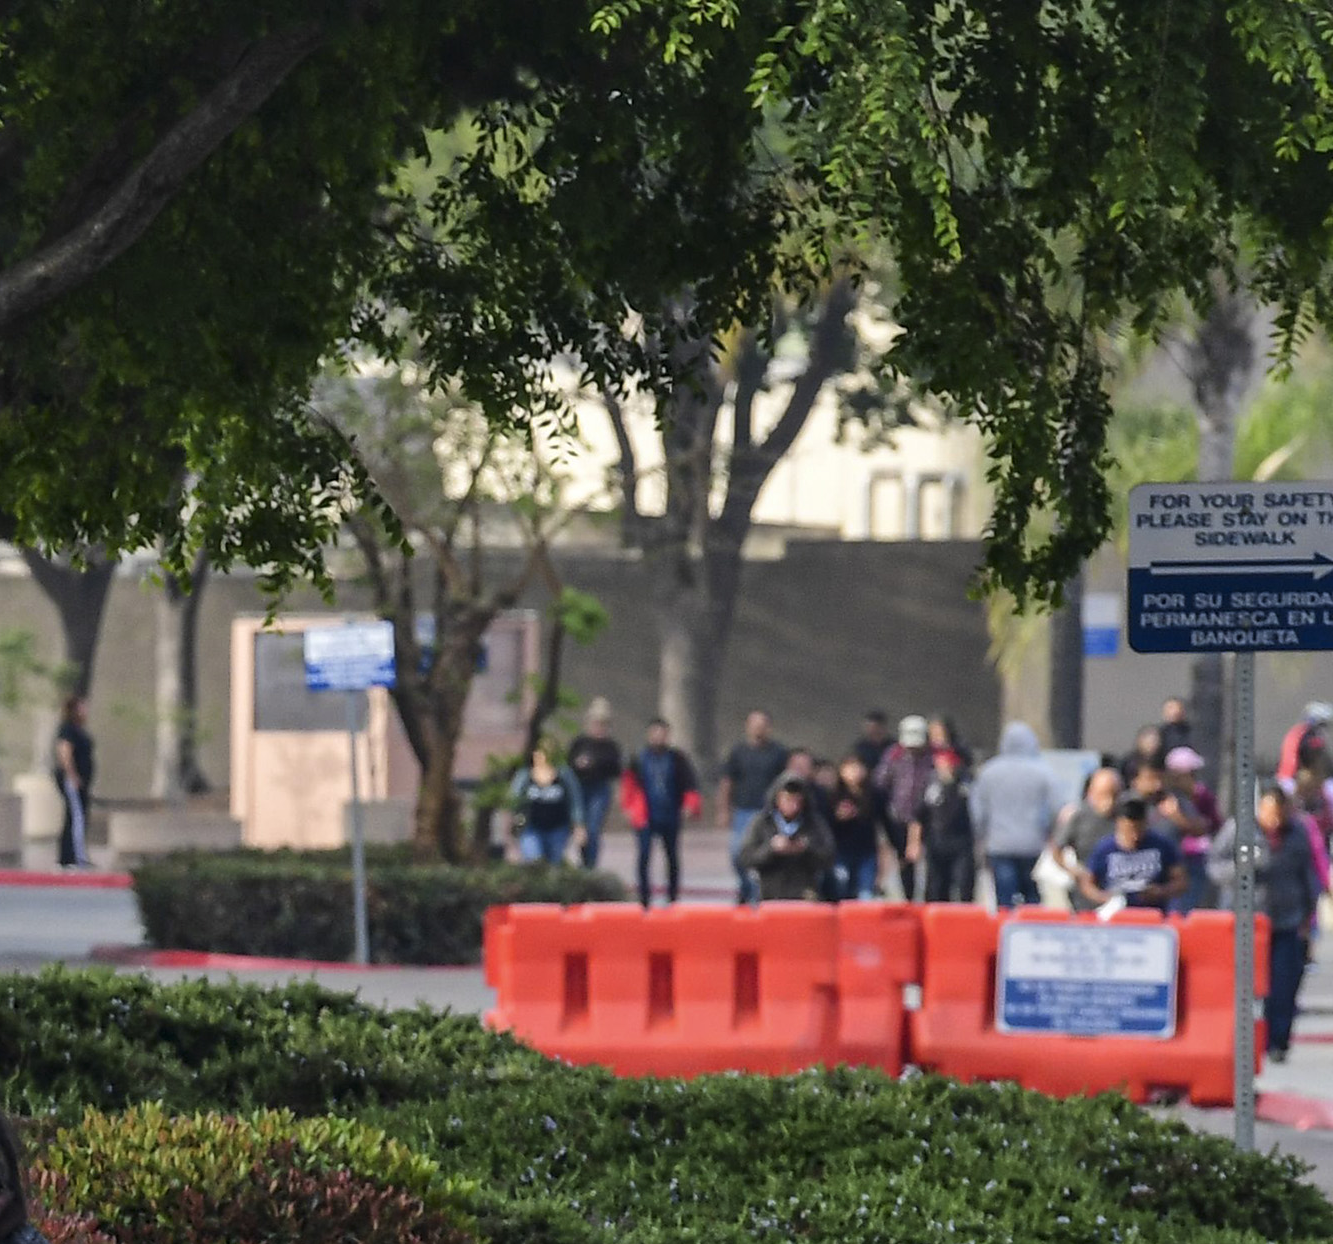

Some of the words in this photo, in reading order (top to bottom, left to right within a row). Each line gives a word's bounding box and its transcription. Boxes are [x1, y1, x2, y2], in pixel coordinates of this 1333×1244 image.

[1149, 494, 1190, 510] FOR
[1199, 494, 1254, 508] YOUR
[1137, 513, 1212, 528] PLEASE
[1222, 512, 1268, 528] STAY
[1278, 512, 1307, 526] ON
[1195, 531, 1296, 546] SIDEWALK
[1142, 594, 1185, 609] POR
[1194, 593, 1222, 608] SU
[1231, 592, 1333, 608] SEGURIDA
[1140, 611, 1279, 628] PERMANESCA
[1288, 610, 1315, 625] EN
[1323, 611, 1333, 625] L
[1191, 629, 1299, 646] BANQUETA
